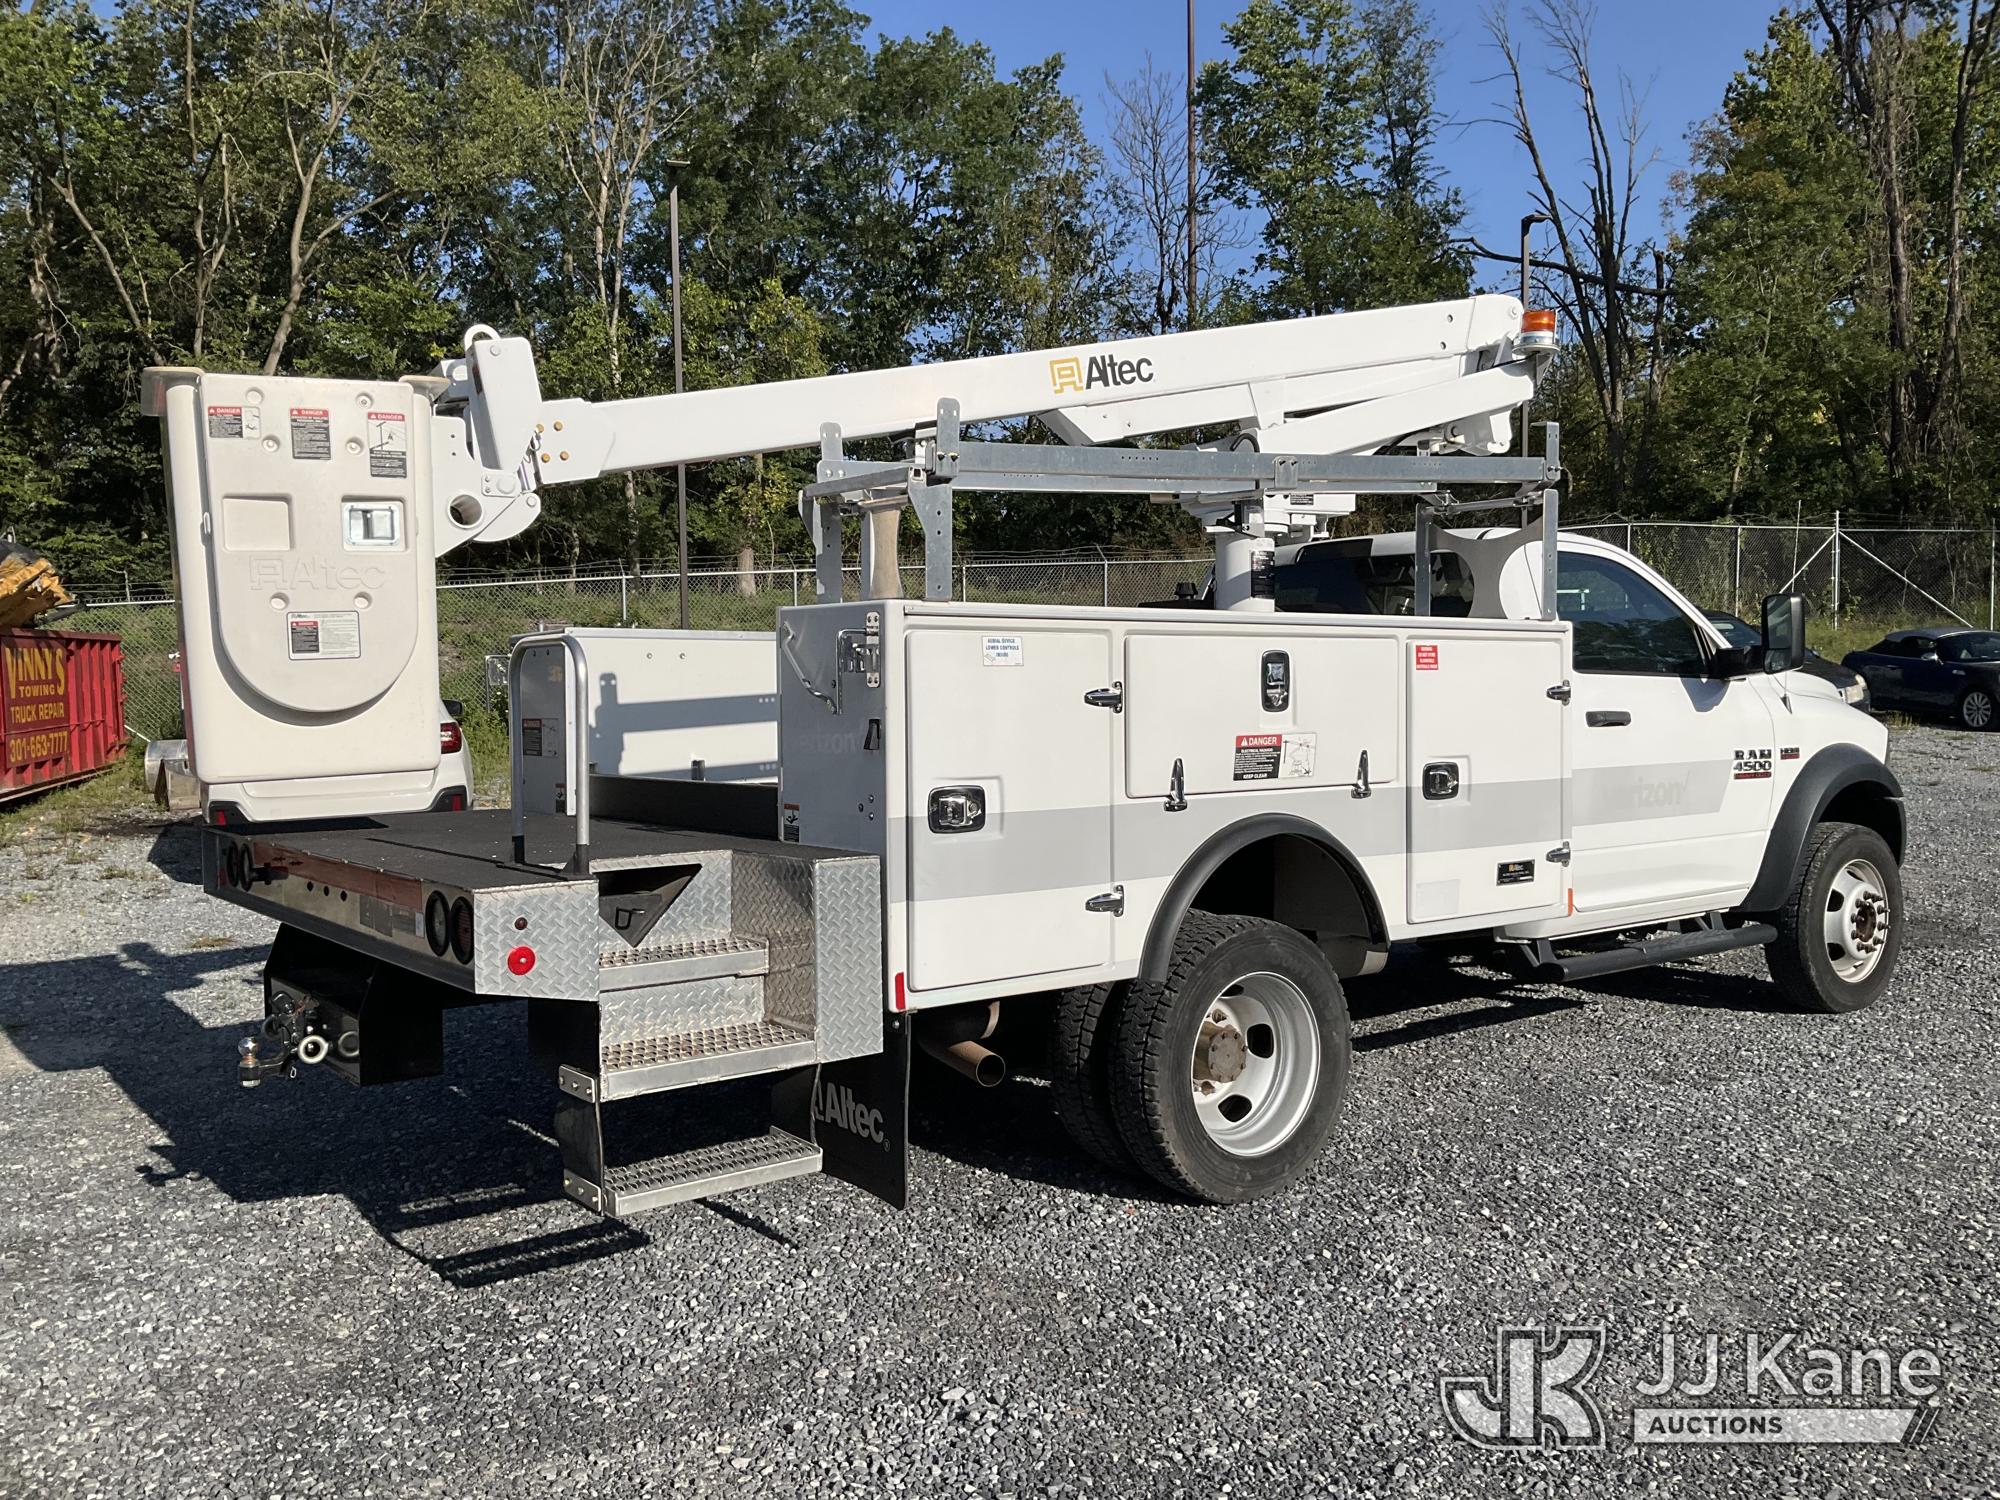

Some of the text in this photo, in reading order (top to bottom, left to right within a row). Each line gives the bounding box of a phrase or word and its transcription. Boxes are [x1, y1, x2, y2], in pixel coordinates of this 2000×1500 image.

[1085, 354, 1154, 390] Altec
[289, 556, 385, 590] Altec
[19, 684, 55, 698] TOWING
[10, 702, 65, 724] TRUCK REPAIR
[9, 731, 68, 762] 301-663-7777
[1248, 736, 1277, 746] DANGER
[1733, 760, 1772, 771] 4500
[1734, 749, 1772, 760] RAM
[825, 1082, 884, 1143] Altec
